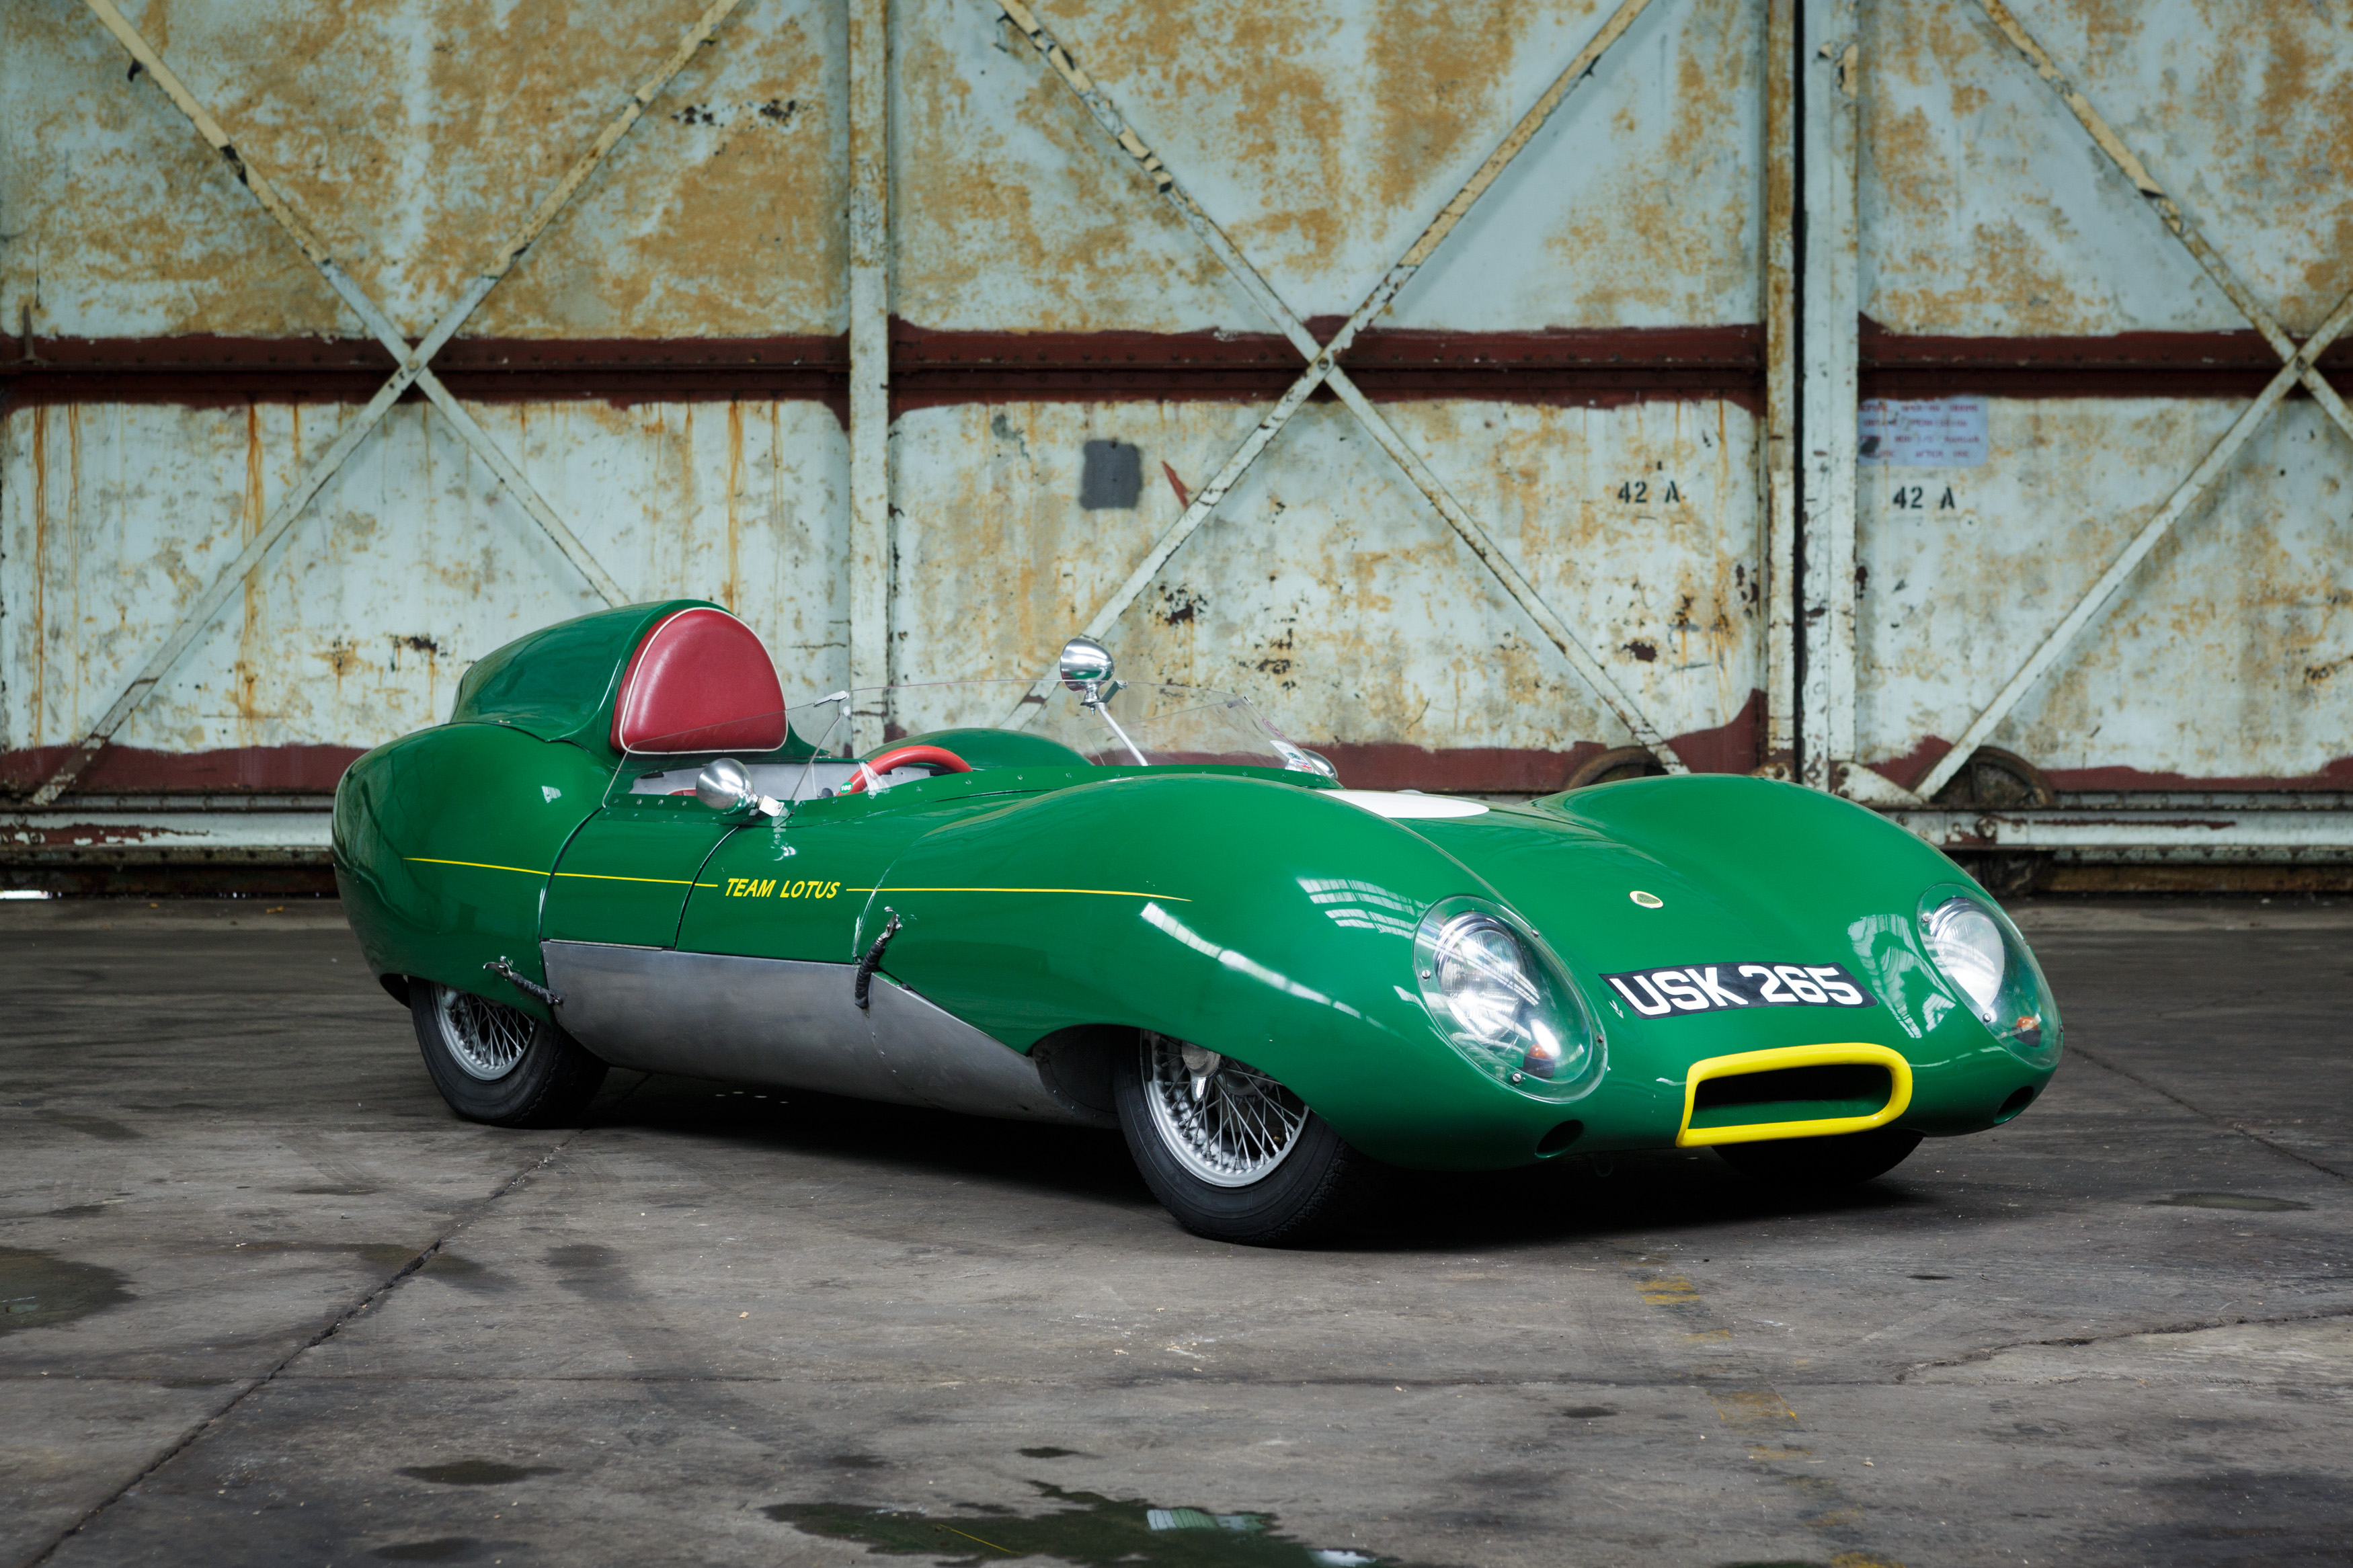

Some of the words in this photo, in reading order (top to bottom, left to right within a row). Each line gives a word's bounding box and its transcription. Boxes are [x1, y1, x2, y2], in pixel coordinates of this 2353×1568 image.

[1618, 481, 1648, 503] 42
[1665, 480, 1680, 503] A
[1892, 486, 1923, 509] 42
[1940, 486, 1955, 509] A
[725, 878, 776, 897] TEAM
[780, 880, 841, 899] LOTUS
[1609, 966, 1749, 1016] USK
[1739, 965, 1863, 1005] 265
